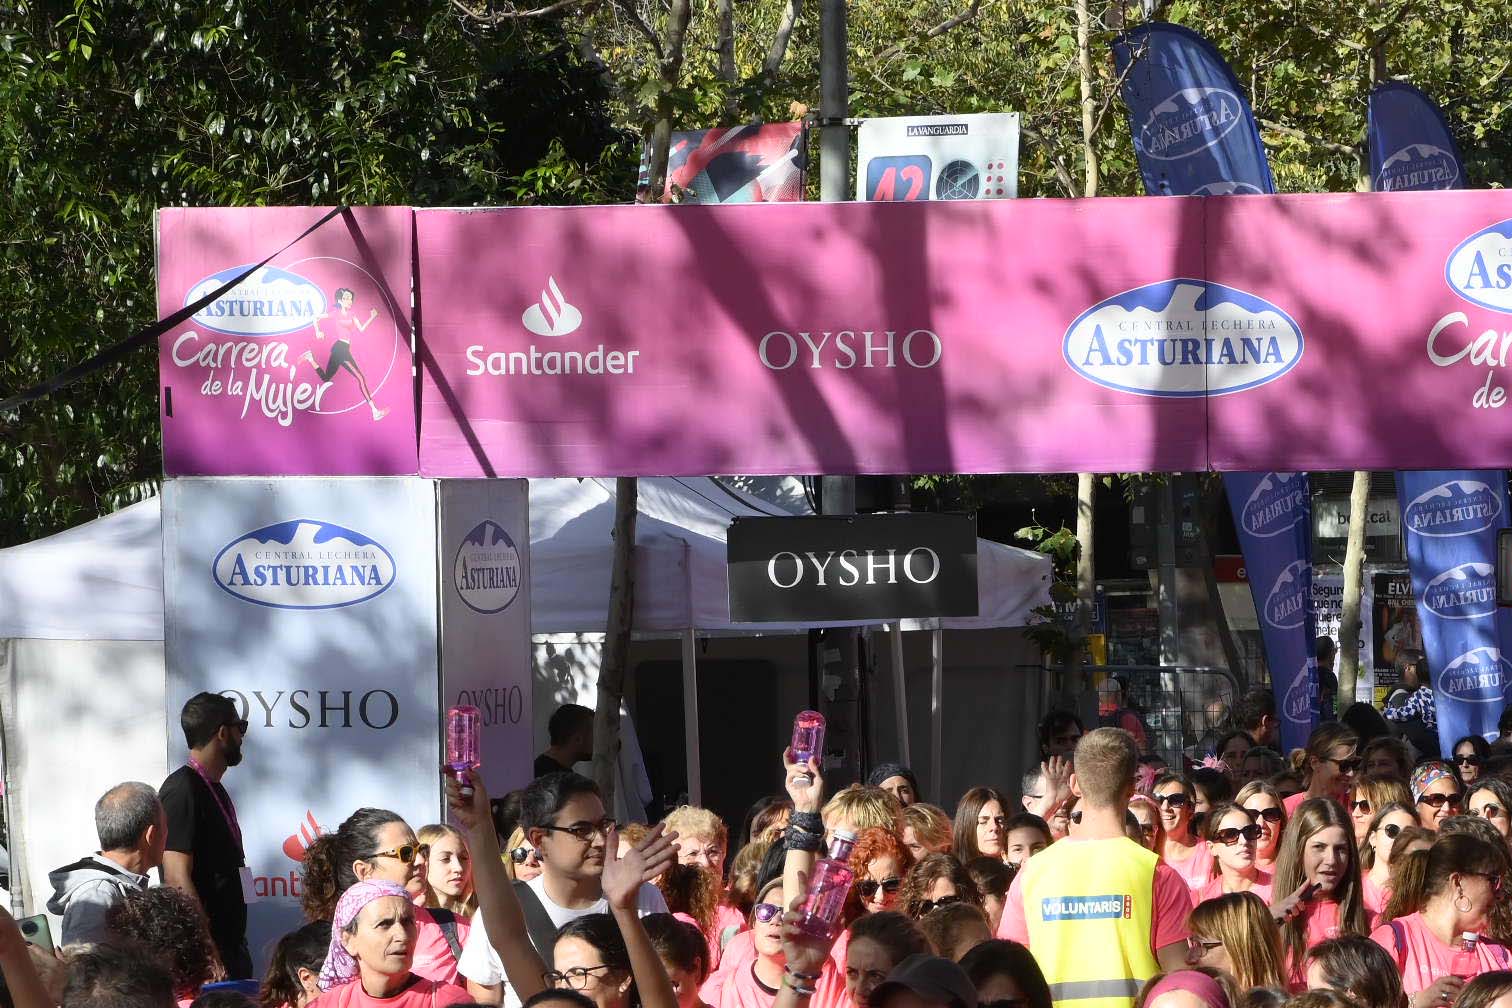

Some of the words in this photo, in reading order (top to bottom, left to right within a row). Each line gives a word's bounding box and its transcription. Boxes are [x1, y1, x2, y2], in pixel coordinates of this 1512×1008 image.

[196, 290, 316, 317] ASTURIANA
[1118, 319, 1193, 331] CENTRAL
[1201, 319, 1277, 331] LECHERA
[172, 331, 289, 368] Carrera
[466, 345, 640, 376] Santander
[759, 329, 942, 371] OYSHO
[1082, 324, 1285, 366] ASTURIANA
[201, 370, 223, 396] de
[227, 370, 244, 396] la
[240, 363, 334, 427] Mujer
[1472, 370, 1506, 410] de
[227, 552, 383, 587] ASTURIANA
[254, 551, 313, 560] CENTRAL
[319, 551, 377, 560] LECHERA
[767, 546, 941, 588] OYSHO
[459, 565, 518, 591] ASTURIANA
[1042, 900, 1121, 916] VOLUNTARIS
